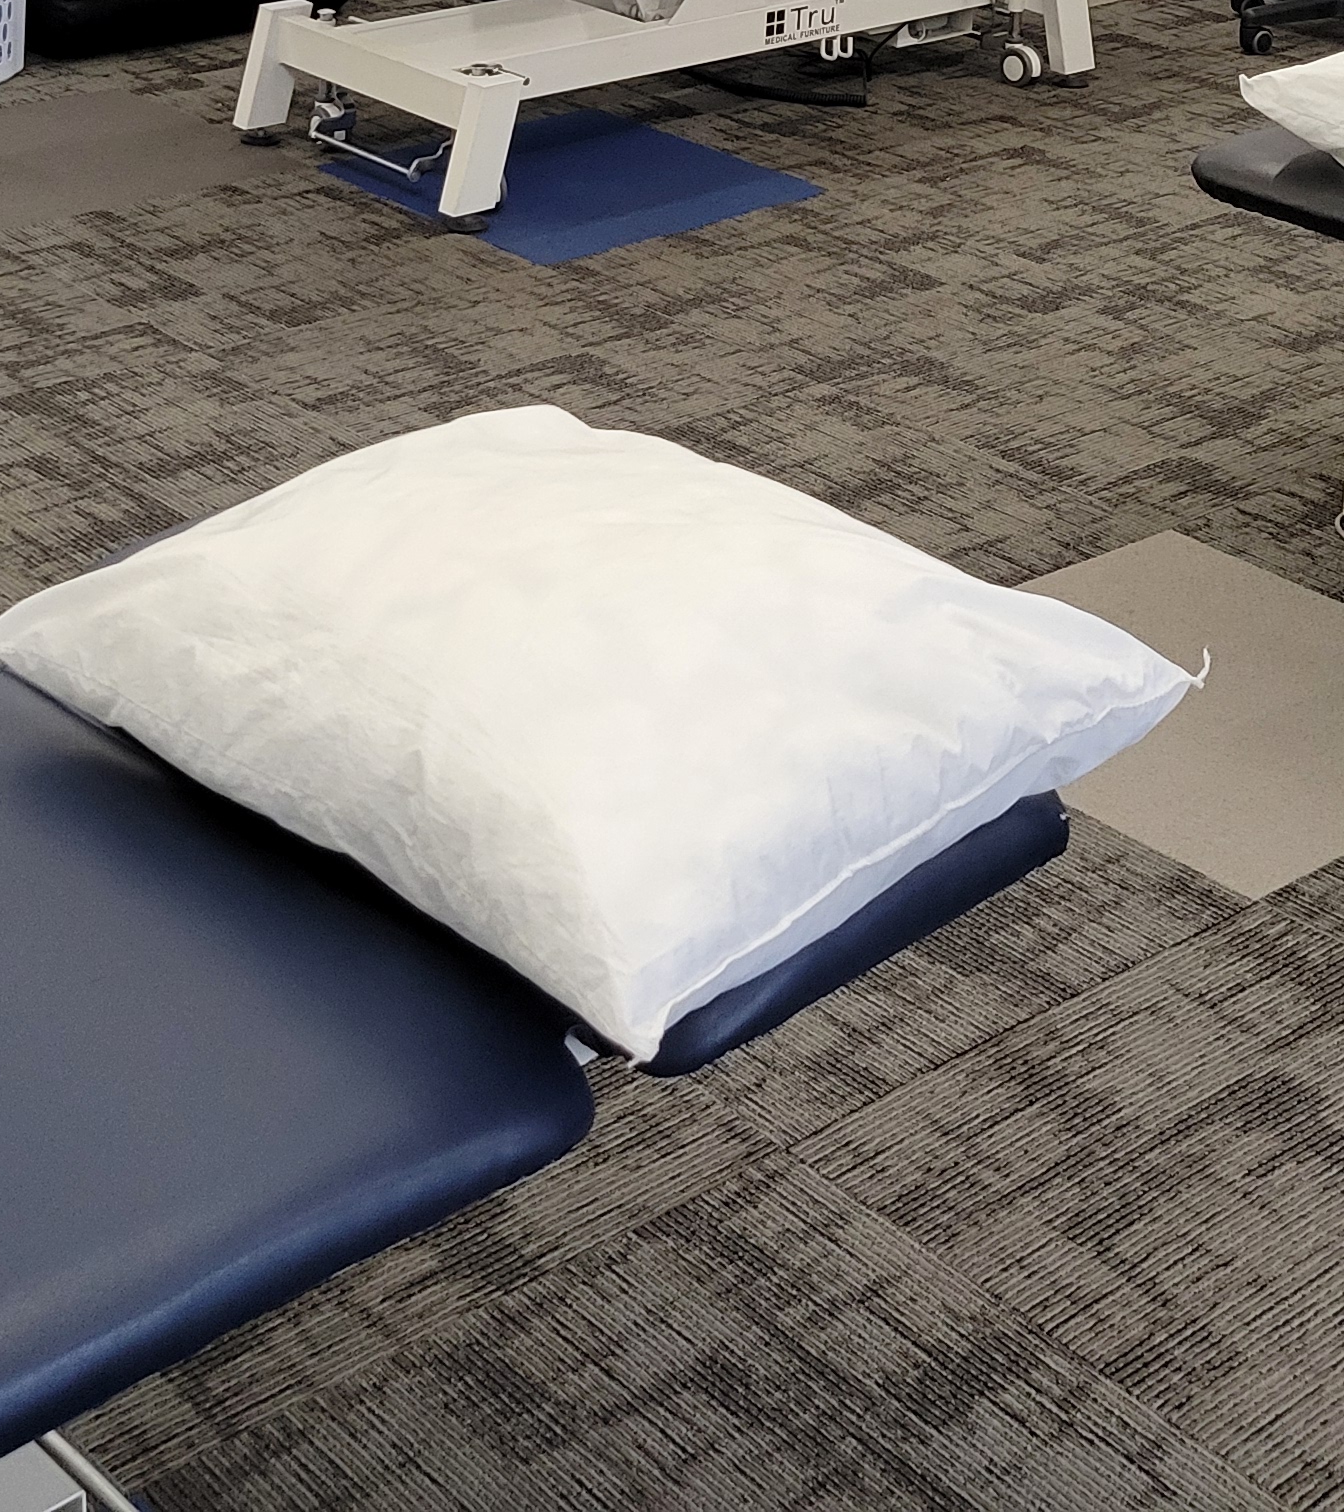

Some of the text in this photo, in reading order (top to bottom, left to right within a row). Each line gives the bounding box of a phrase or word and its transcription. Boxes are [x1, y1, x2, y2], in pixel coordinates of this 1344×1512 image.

[790, 5, 835, 30] Tru
[764, 24, 841, 45] MEDICAL FURNITURE
